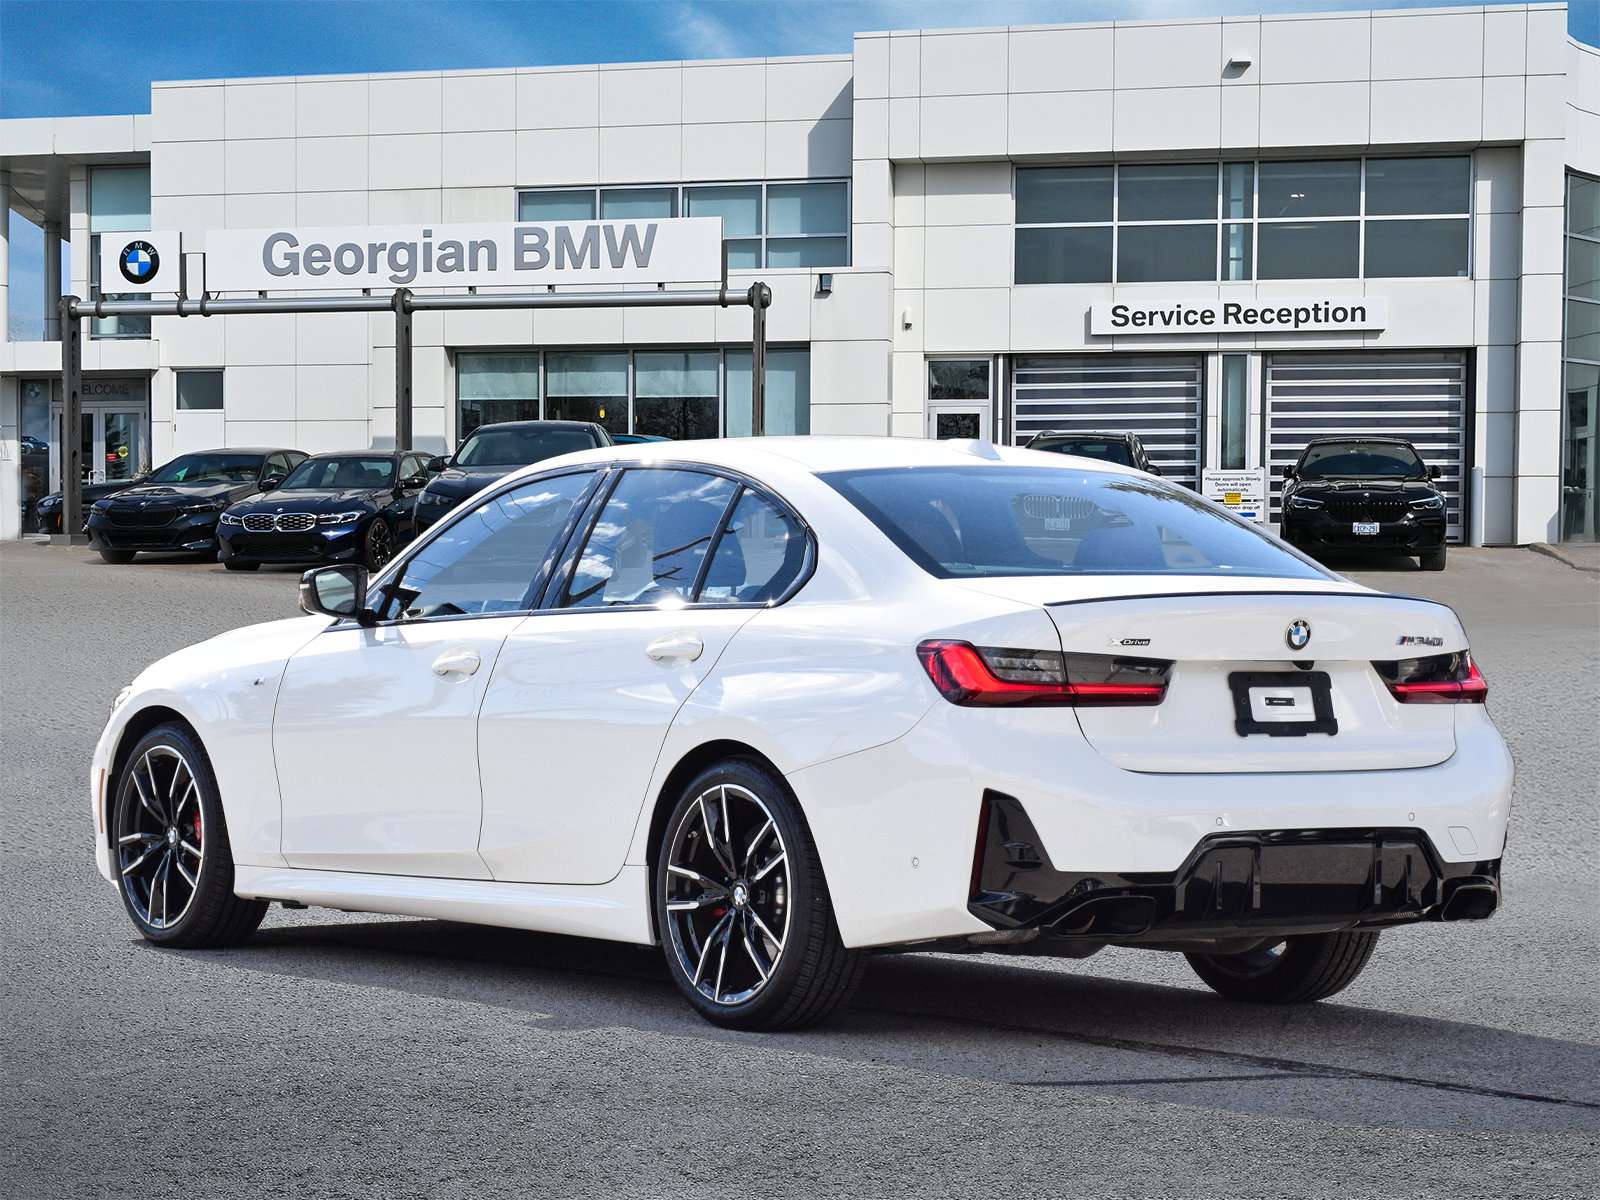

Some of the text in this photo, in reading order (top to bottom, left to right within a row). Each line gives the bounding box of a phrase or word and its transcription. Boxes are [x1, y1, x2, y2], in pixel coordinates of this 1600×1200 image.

[262, 223, 658, 284] Georgian BMW
[1111, 301, 1366, 328] Service Reception
[81, 383, 129, 395] ELCOME
